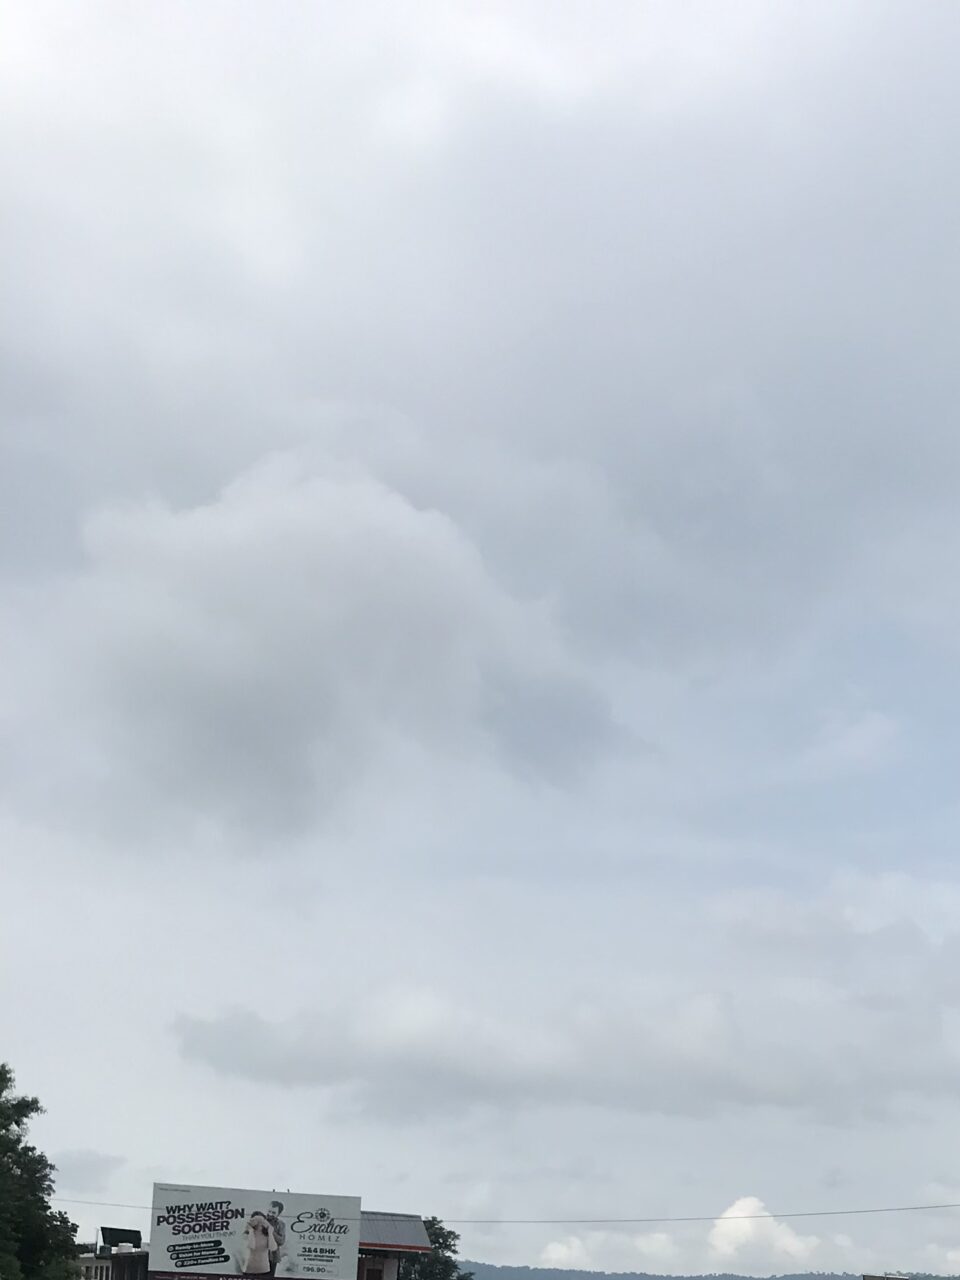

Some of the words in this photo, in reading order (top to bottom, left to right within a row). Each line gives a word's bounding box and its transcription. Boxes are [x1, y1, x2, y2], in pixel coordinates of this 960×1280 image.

[165, 1203, 195, 1215] WHY
[196, 1200, 232, 1212] WAIT?
[156, 1208, 245, 1226] POSSESSION
[290, 1211, 350, 1235] Exotica
[172, 1220, 230, 1235] SOONER
[319, 1247, 337, 1255] BHK
